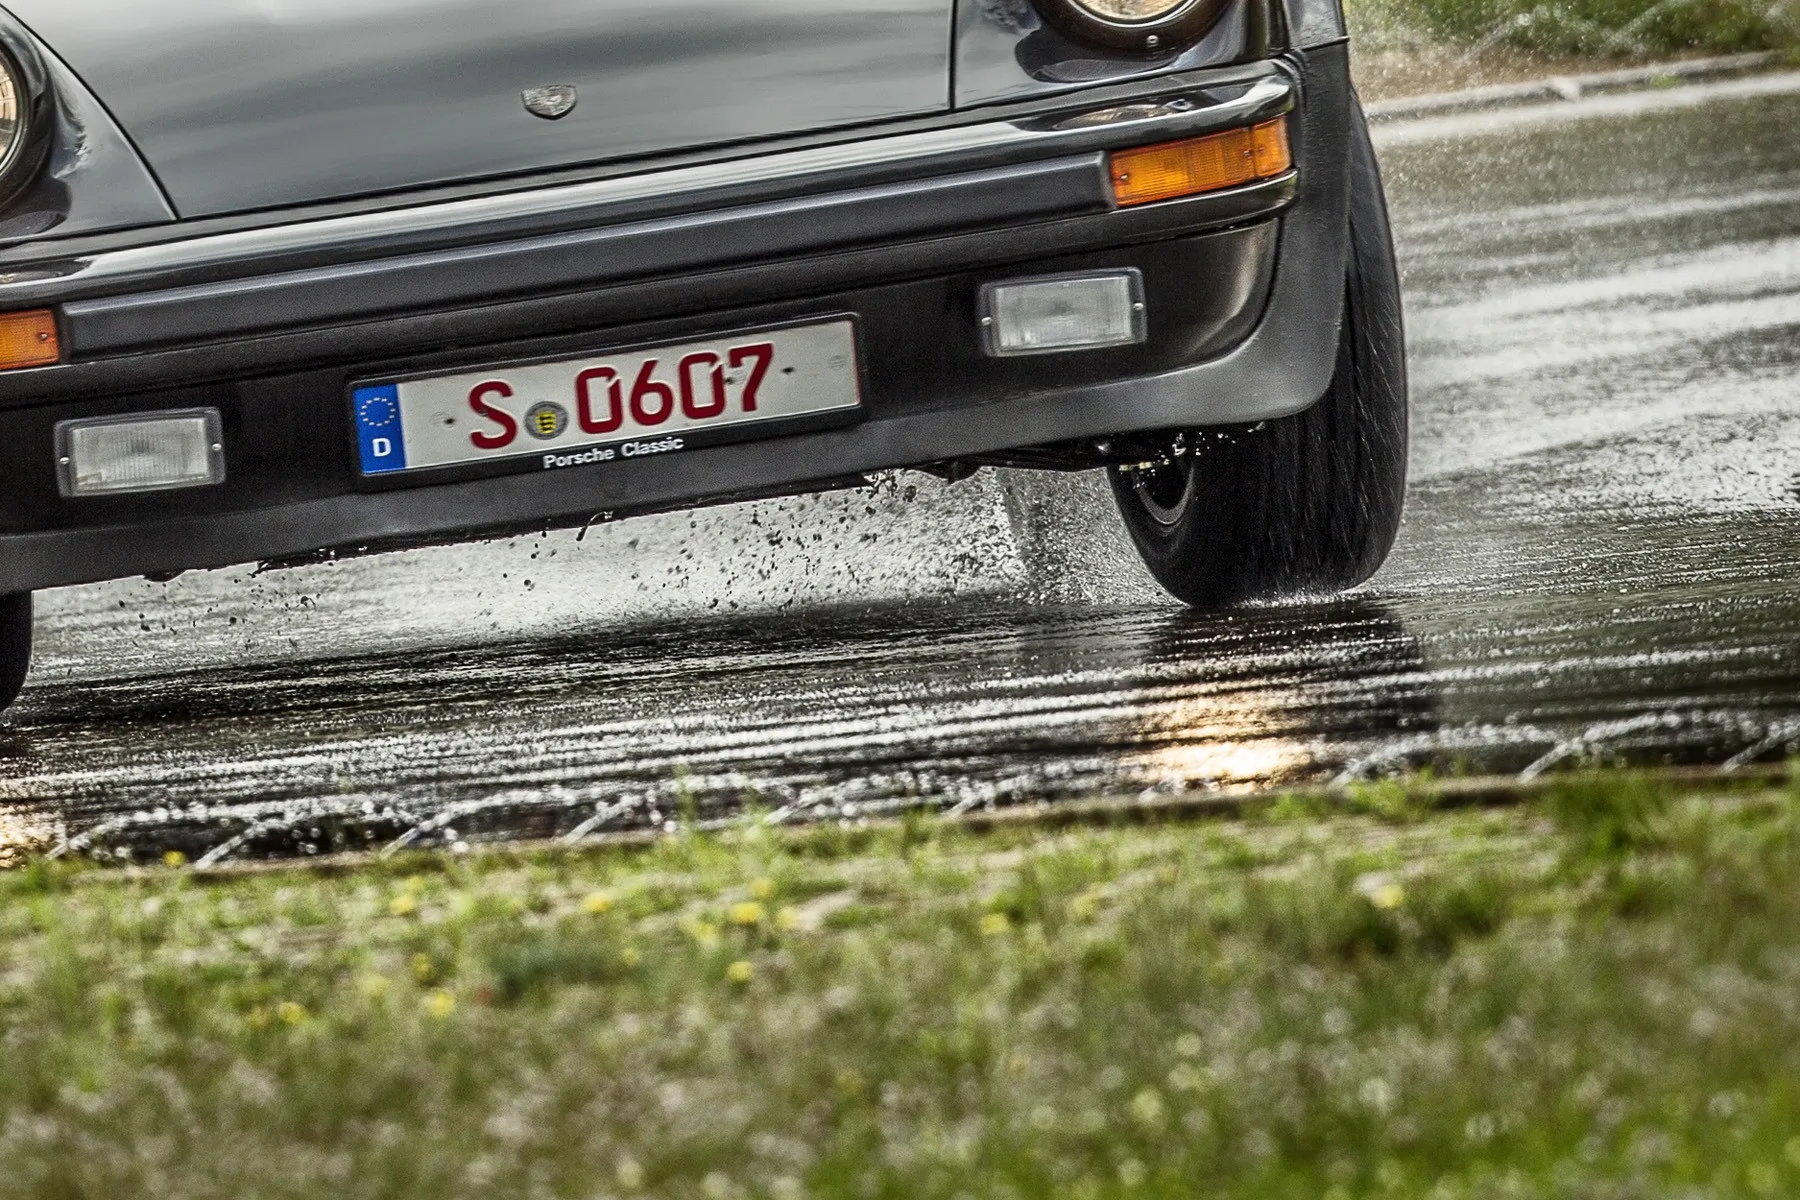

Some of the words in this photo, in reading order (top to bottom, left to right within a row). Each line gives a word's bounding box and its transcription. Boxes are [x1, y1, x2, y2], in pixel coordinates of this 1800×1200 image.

[469, 379, 518, 449] S
[574, 342, 774, 435] 0607
[372, 437, 392, 457] D
[543, 447, 615, 469] Porsche
[621, 436, 684, 457] Classic
